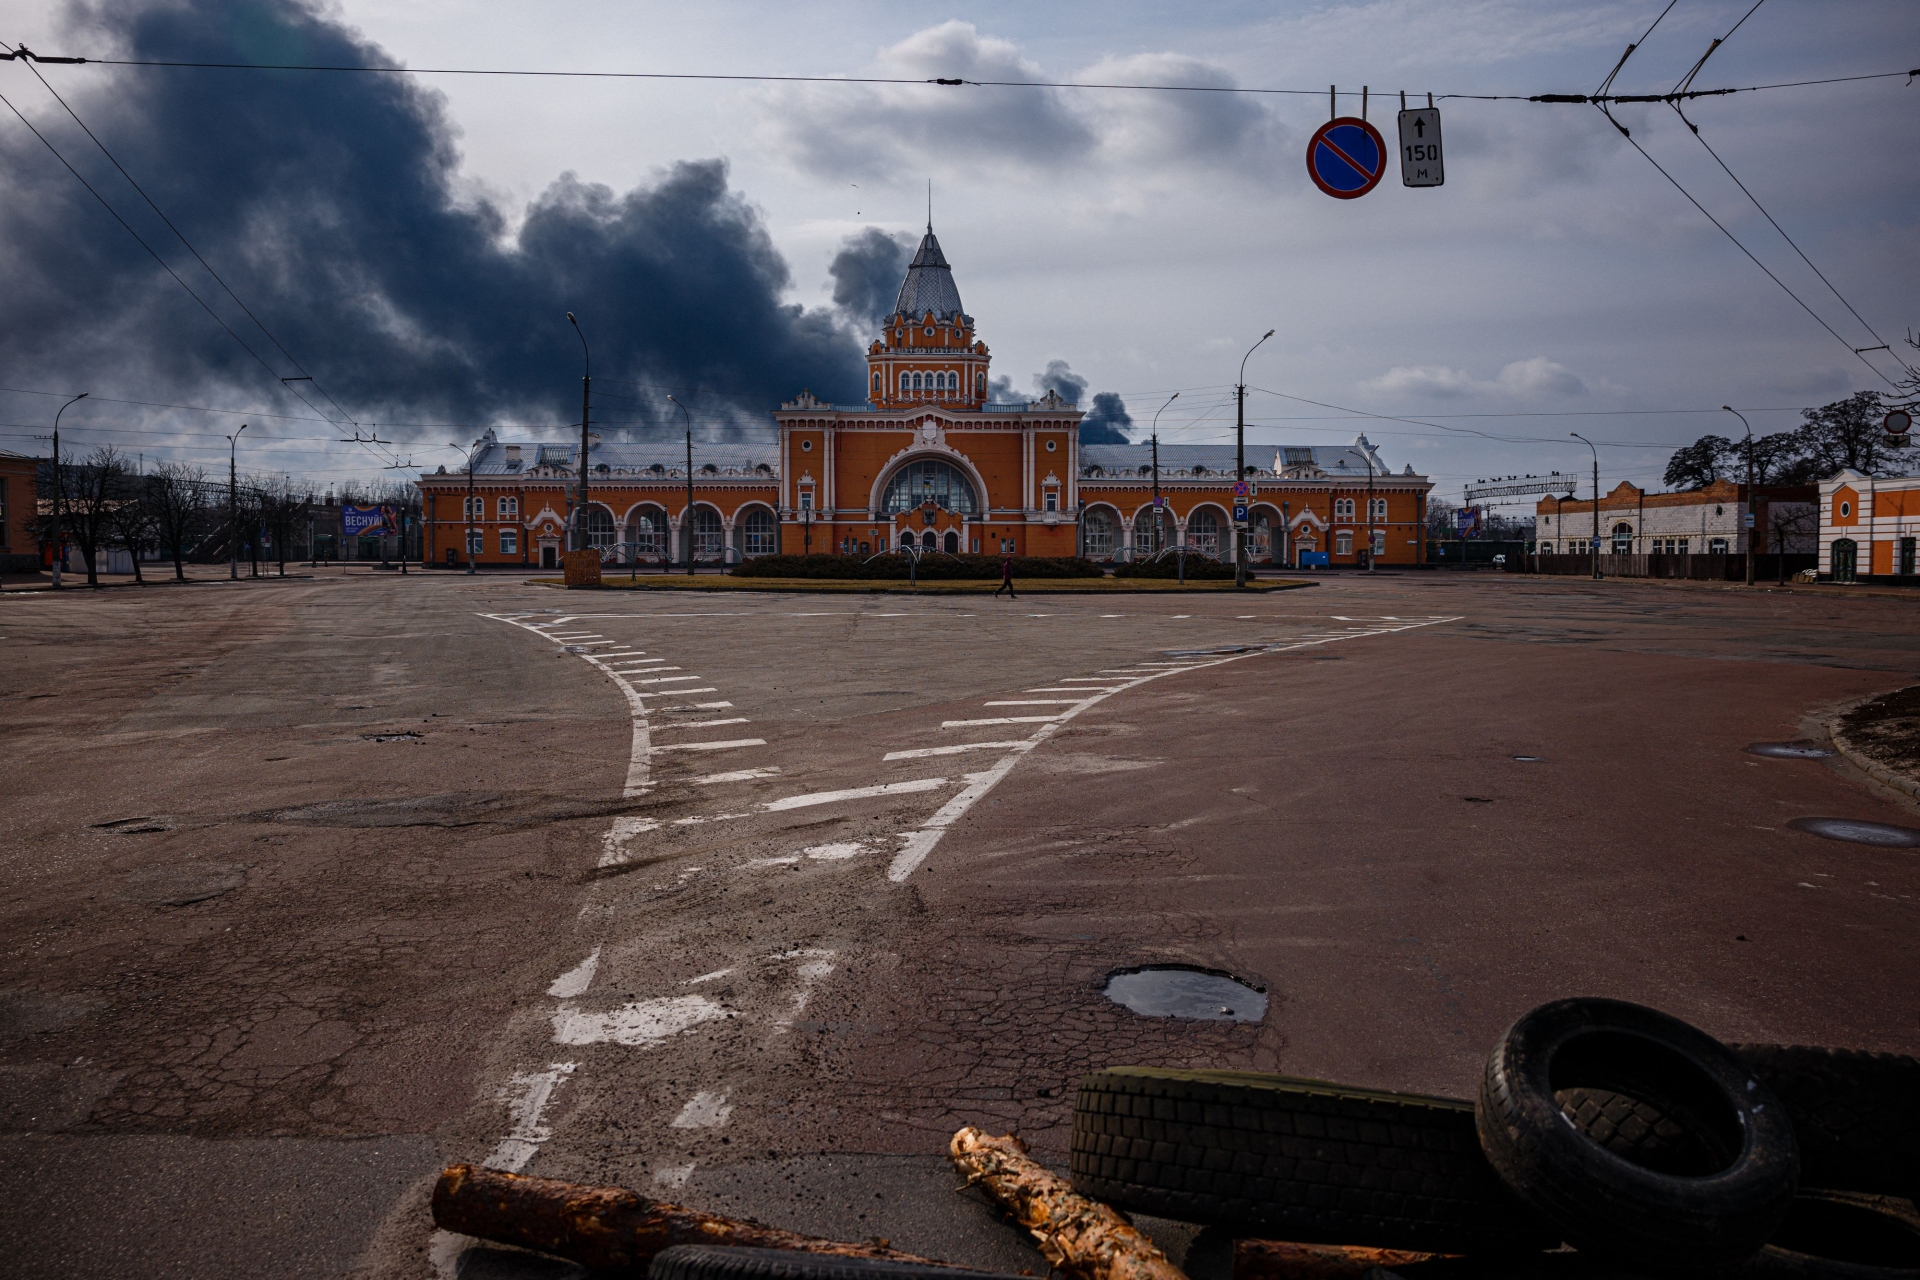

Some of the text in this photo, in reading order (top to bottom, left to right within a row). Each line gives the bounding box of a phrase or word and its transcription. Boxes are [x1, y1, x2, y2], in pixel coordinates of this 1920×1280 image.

[1405, 144, 1438, 162] 150
[1236, 507, 1245, 519] P
[345, 514, 383, 526] ВЕСНУЙ!
